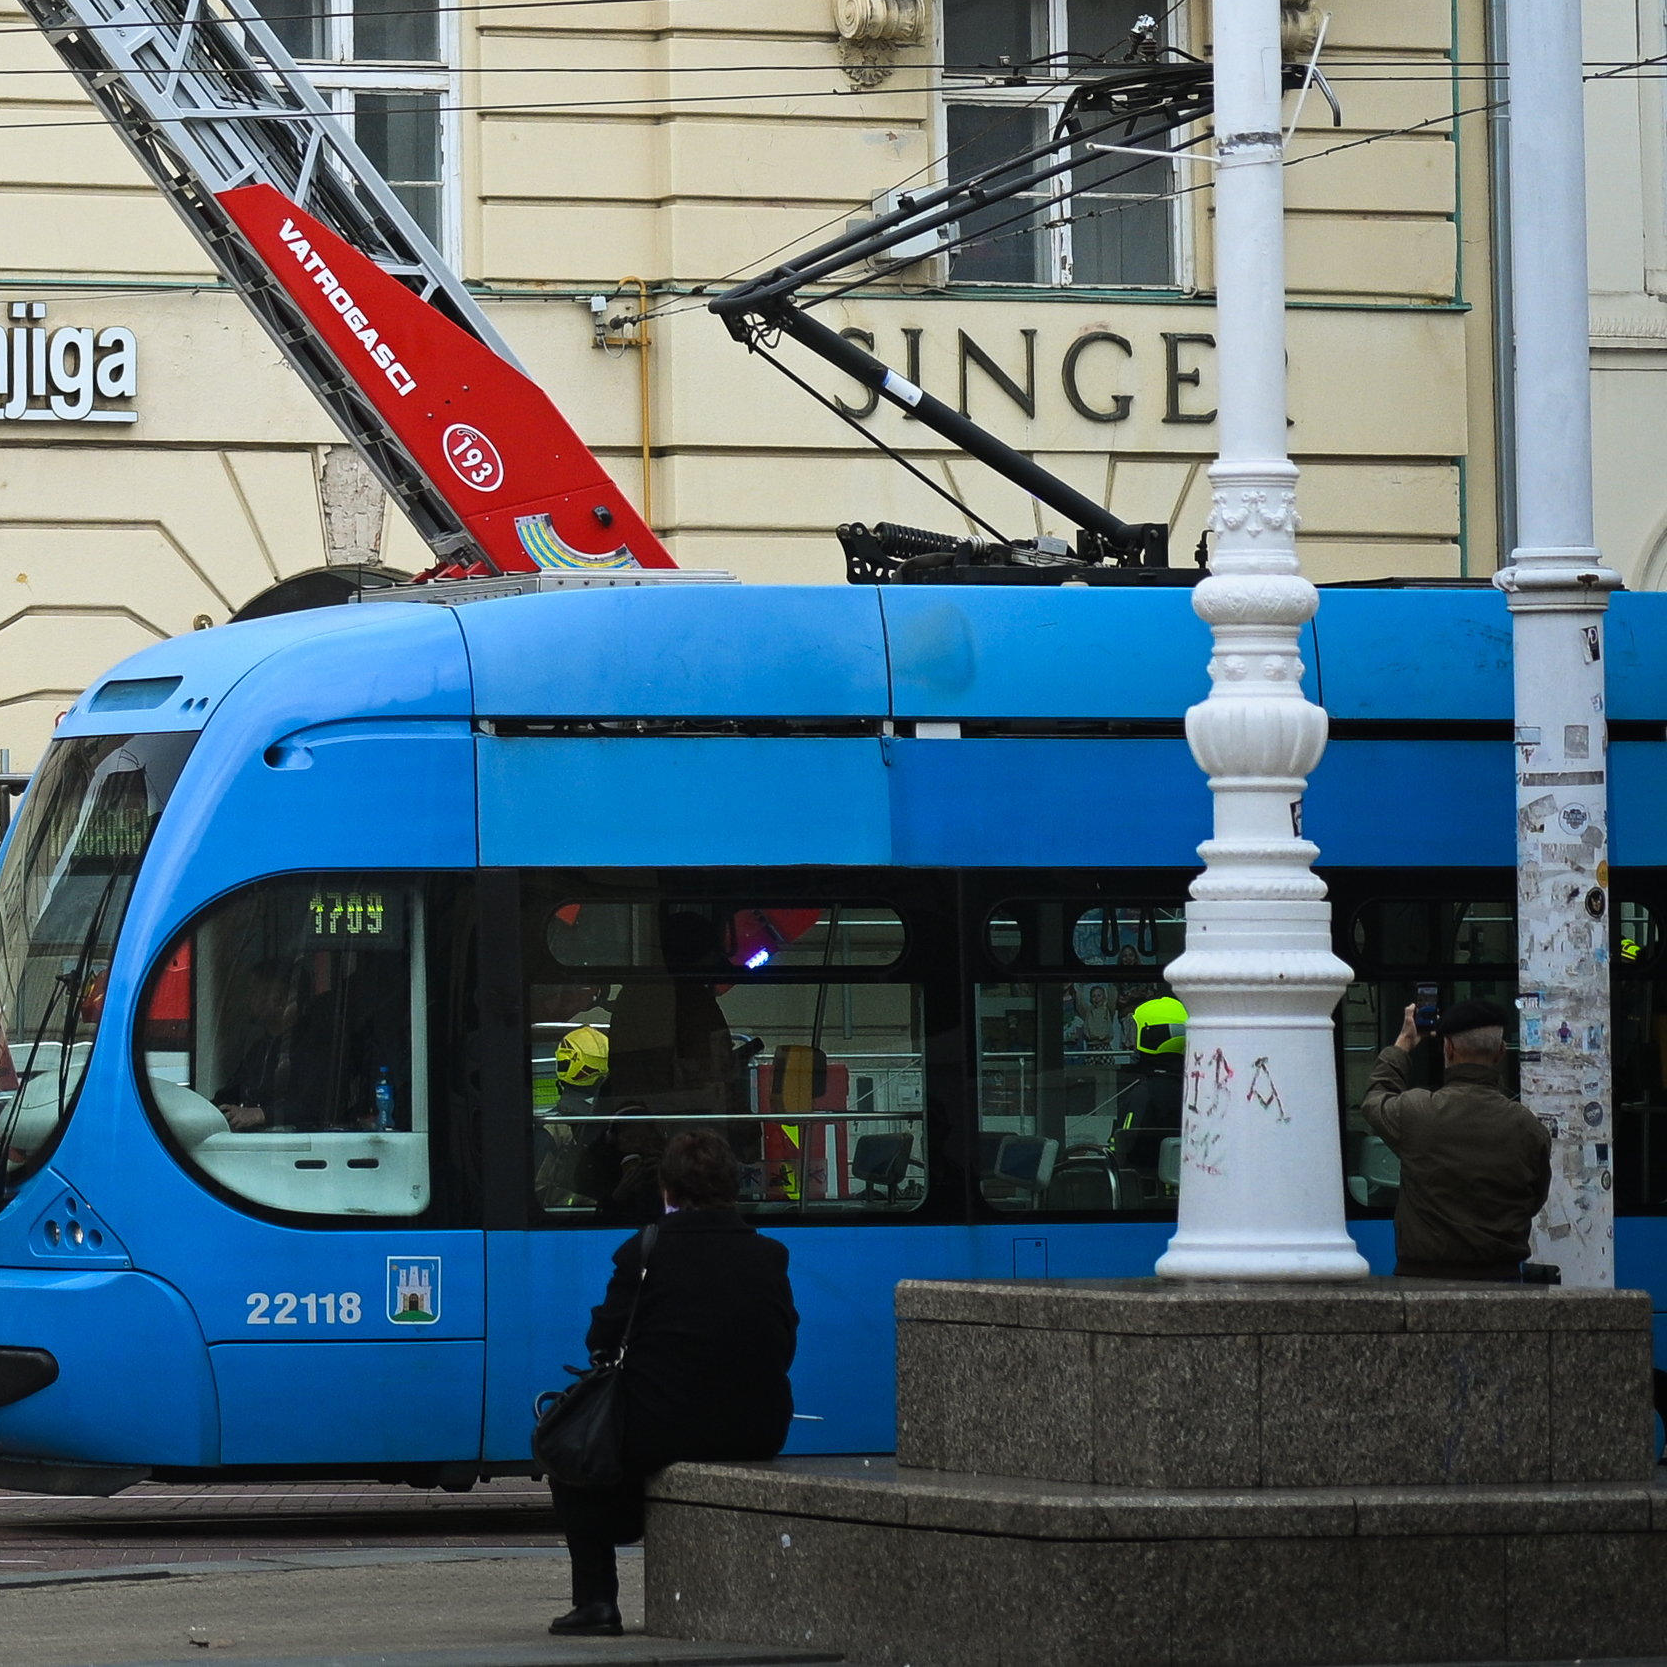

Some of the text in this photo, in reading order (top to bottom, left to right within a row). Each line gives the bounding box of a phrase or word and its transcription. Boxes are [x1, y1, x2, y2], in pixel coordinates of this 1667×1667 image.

[277, 217, 418, 398] VATROGASCI
[833, 326, 1295, 428] SINGE
[452, 435, 494, 484] 193
[309, 893, 383, 934] 1709
[246, 1291, 362, 1324] 22118
